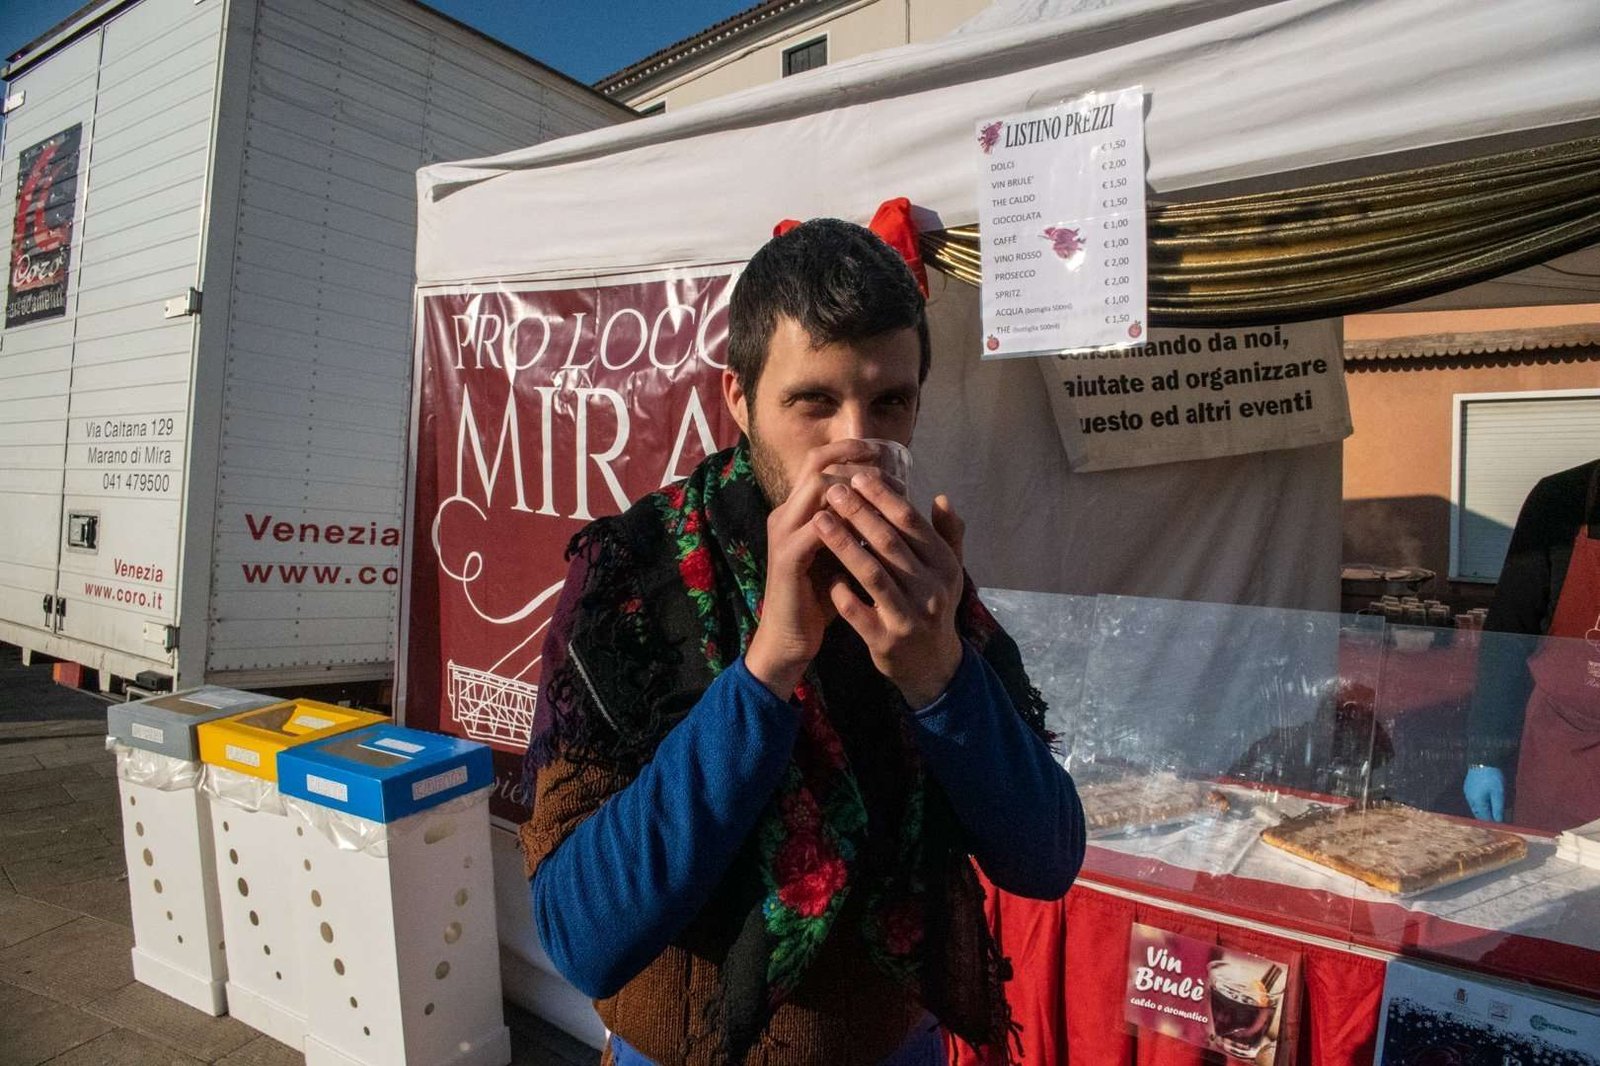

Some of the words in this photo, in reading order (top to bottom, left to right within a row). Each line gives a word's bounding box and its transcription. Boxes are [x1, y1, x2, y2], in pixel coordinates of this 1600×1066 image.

[1005, 116, 1061, 148] LISTINO
[1064, 103, 1116, 138] PREZZI
[990, 161, 1015, 172] DOLCI
[991, 180, 1006, 190] VIN
[1109, 158, 1127, 169] 2,00
[992, 198, 1007, 208] THE
[1008, 194, 1036, 205] CALDO
[1110, 178, 1127, 188] 1,50
[992, 211, 1042, 226] CIOCCOLATA
[1110, 197, 1128, 207] 1,50
[1111, 218, 1129, 229] 1,00
[994, 254, 1014, 264] VINO
[1016, 250, 1042, 262] ROSSO
[1111, 238, 1129, 248] 1,00
[994, 269, 1036, 281] PROSECCO
[1111, 256, 1130, 267] 2,00
[995, 289, 1021, 300] SPRITZ
[1111, 276, 1130, 286] 2,00
[995, 307, 1024, 317] ACQUA
[1112, 294, 1130, 305] 1,00
[1112, 314, 1130, 324] 1,50
[452, 314, 550, 370] PRO
[1208, 328, 1237, 352] da
[1244, 326, 1289, 351] noi,
[1064, 374, 1145, 398] aiutate
[1151, 370, 1179, 392] ad
[1185, 357, 1328, 391] organizzare
[1080, 410, 1143, 434] uesto
[1150, 405, 1179, 428] ed
[1185, 400, 1231, 424] altri
[1239, 390, 1313, 419] eventi
[86, 421, 101, 438] Via
[104, 420, 147, 438] Caltana
[151, 418, 174, 436] 129
[88, 446, 128, 464] Marano
[130, 446, 142, 464] di
[144, 446, 171, 464] Mira
[103, 472, 121, 490] 041
[126, 473, 170, 492] 479500
[245, 513, 399, 546] Venezia
[114, 558, 163, 582] Venezia
[242, 563, 398, 586] www.co
[84, 582, 163, 610] www.coro.it
[1146, 946, 1182, 974] Vin
[1135, 966, 1205, 1001] Brulè
[1130, 997, 1156, 1010] caldo
[1163, 1005, 1209, 1024] aromatico
